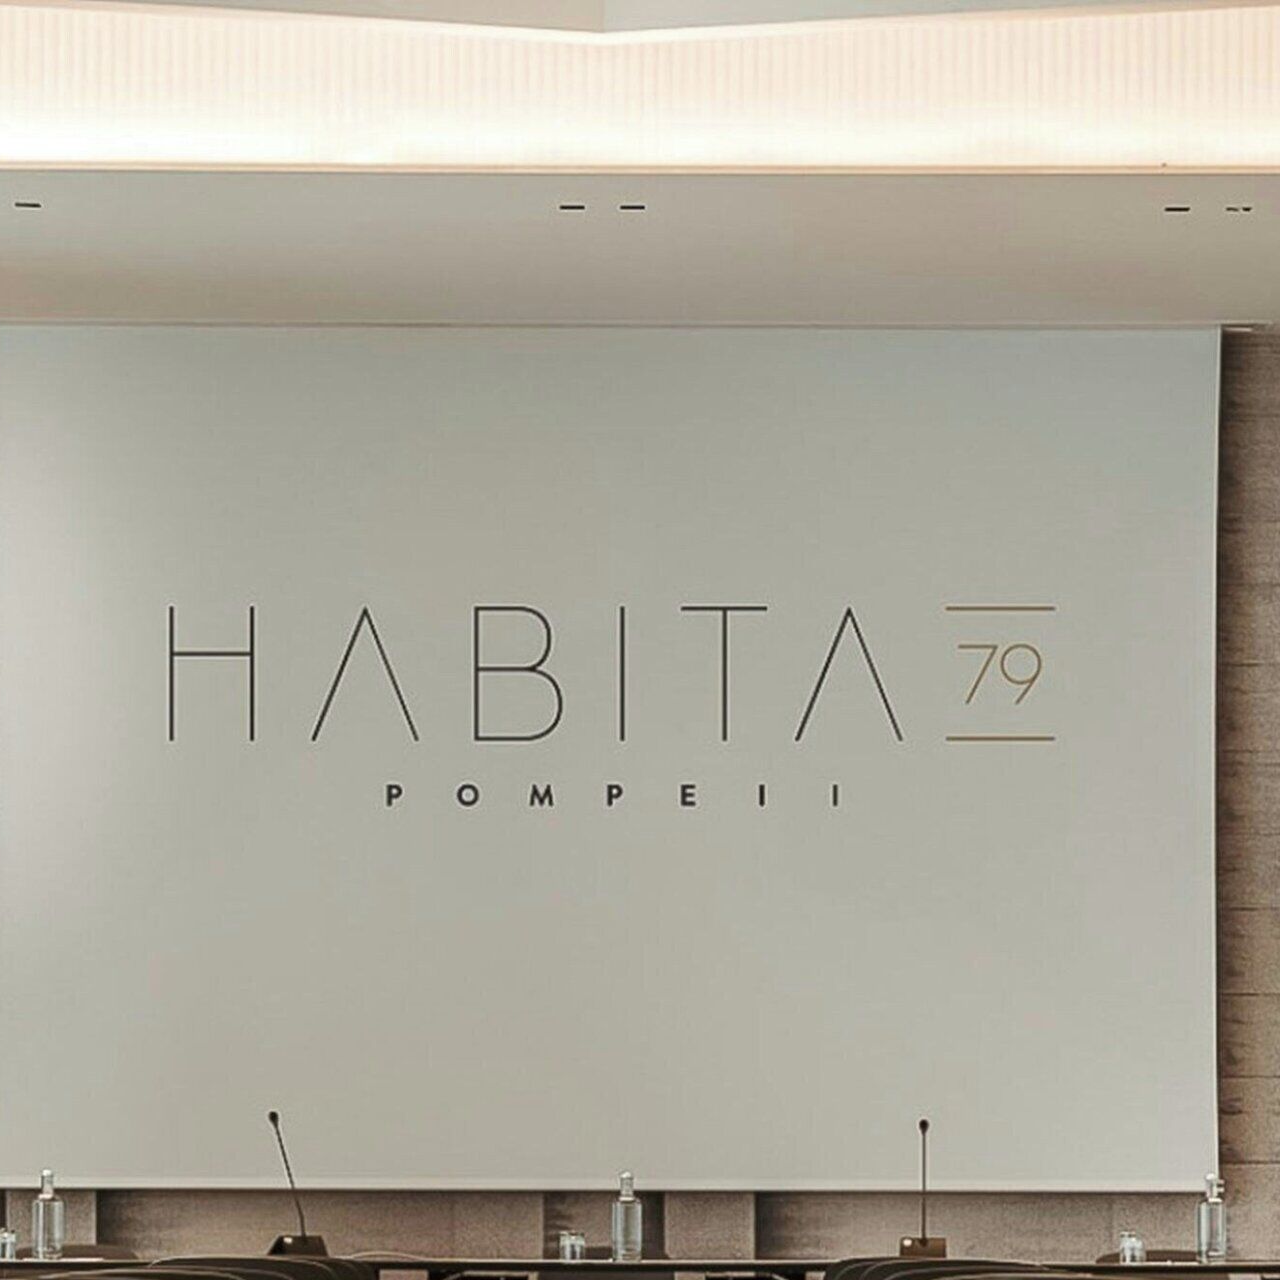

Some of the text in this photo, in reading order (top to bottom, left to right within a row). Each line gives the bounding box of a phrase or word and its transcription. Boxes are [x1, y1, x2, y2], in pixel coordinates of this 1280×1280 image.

[167, 604, 1043, 742] HABITA 79
[385, 783, 840, 807] POMPEII
